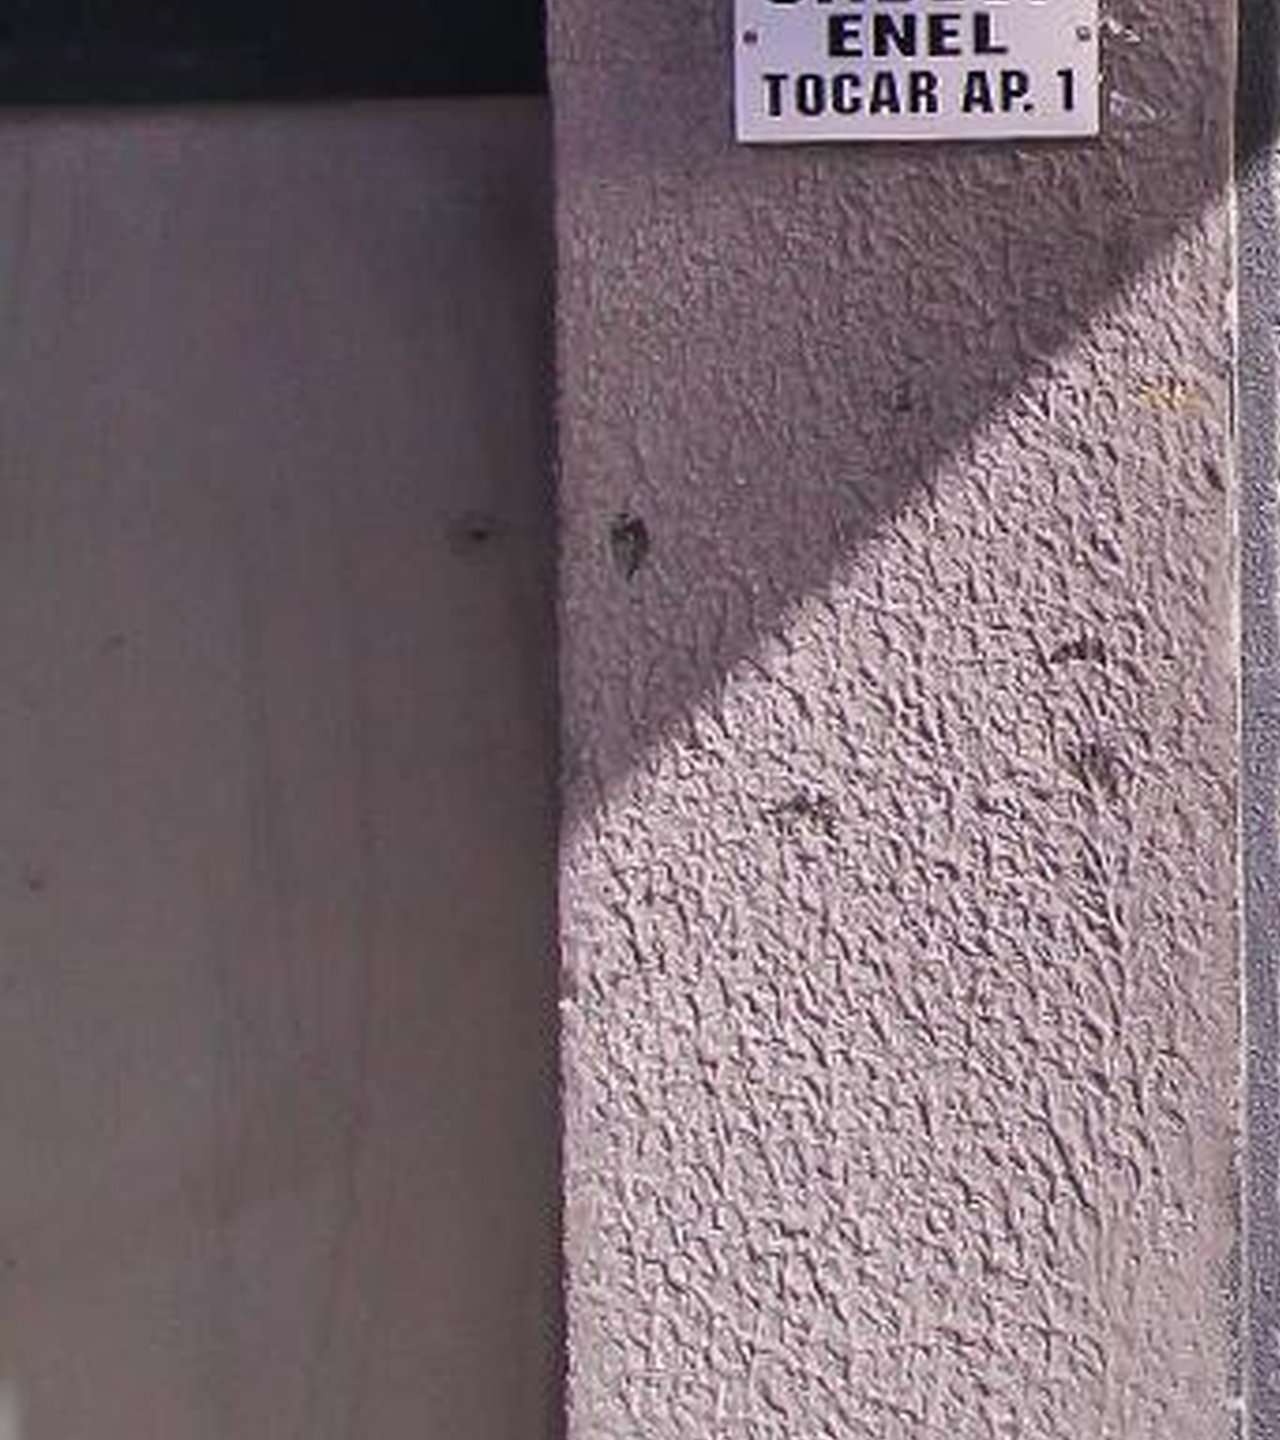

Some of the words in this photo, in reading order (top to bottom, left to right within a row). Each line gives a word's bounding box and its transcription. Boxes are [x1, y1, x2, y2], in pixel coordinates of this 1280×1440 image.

[828, 12, 1009, 57] ENEL
[763, 70, 938, 116] TOCAR
[962, 70, 1033, 113] AP.
[1057, 69, 1075, 111] 1
